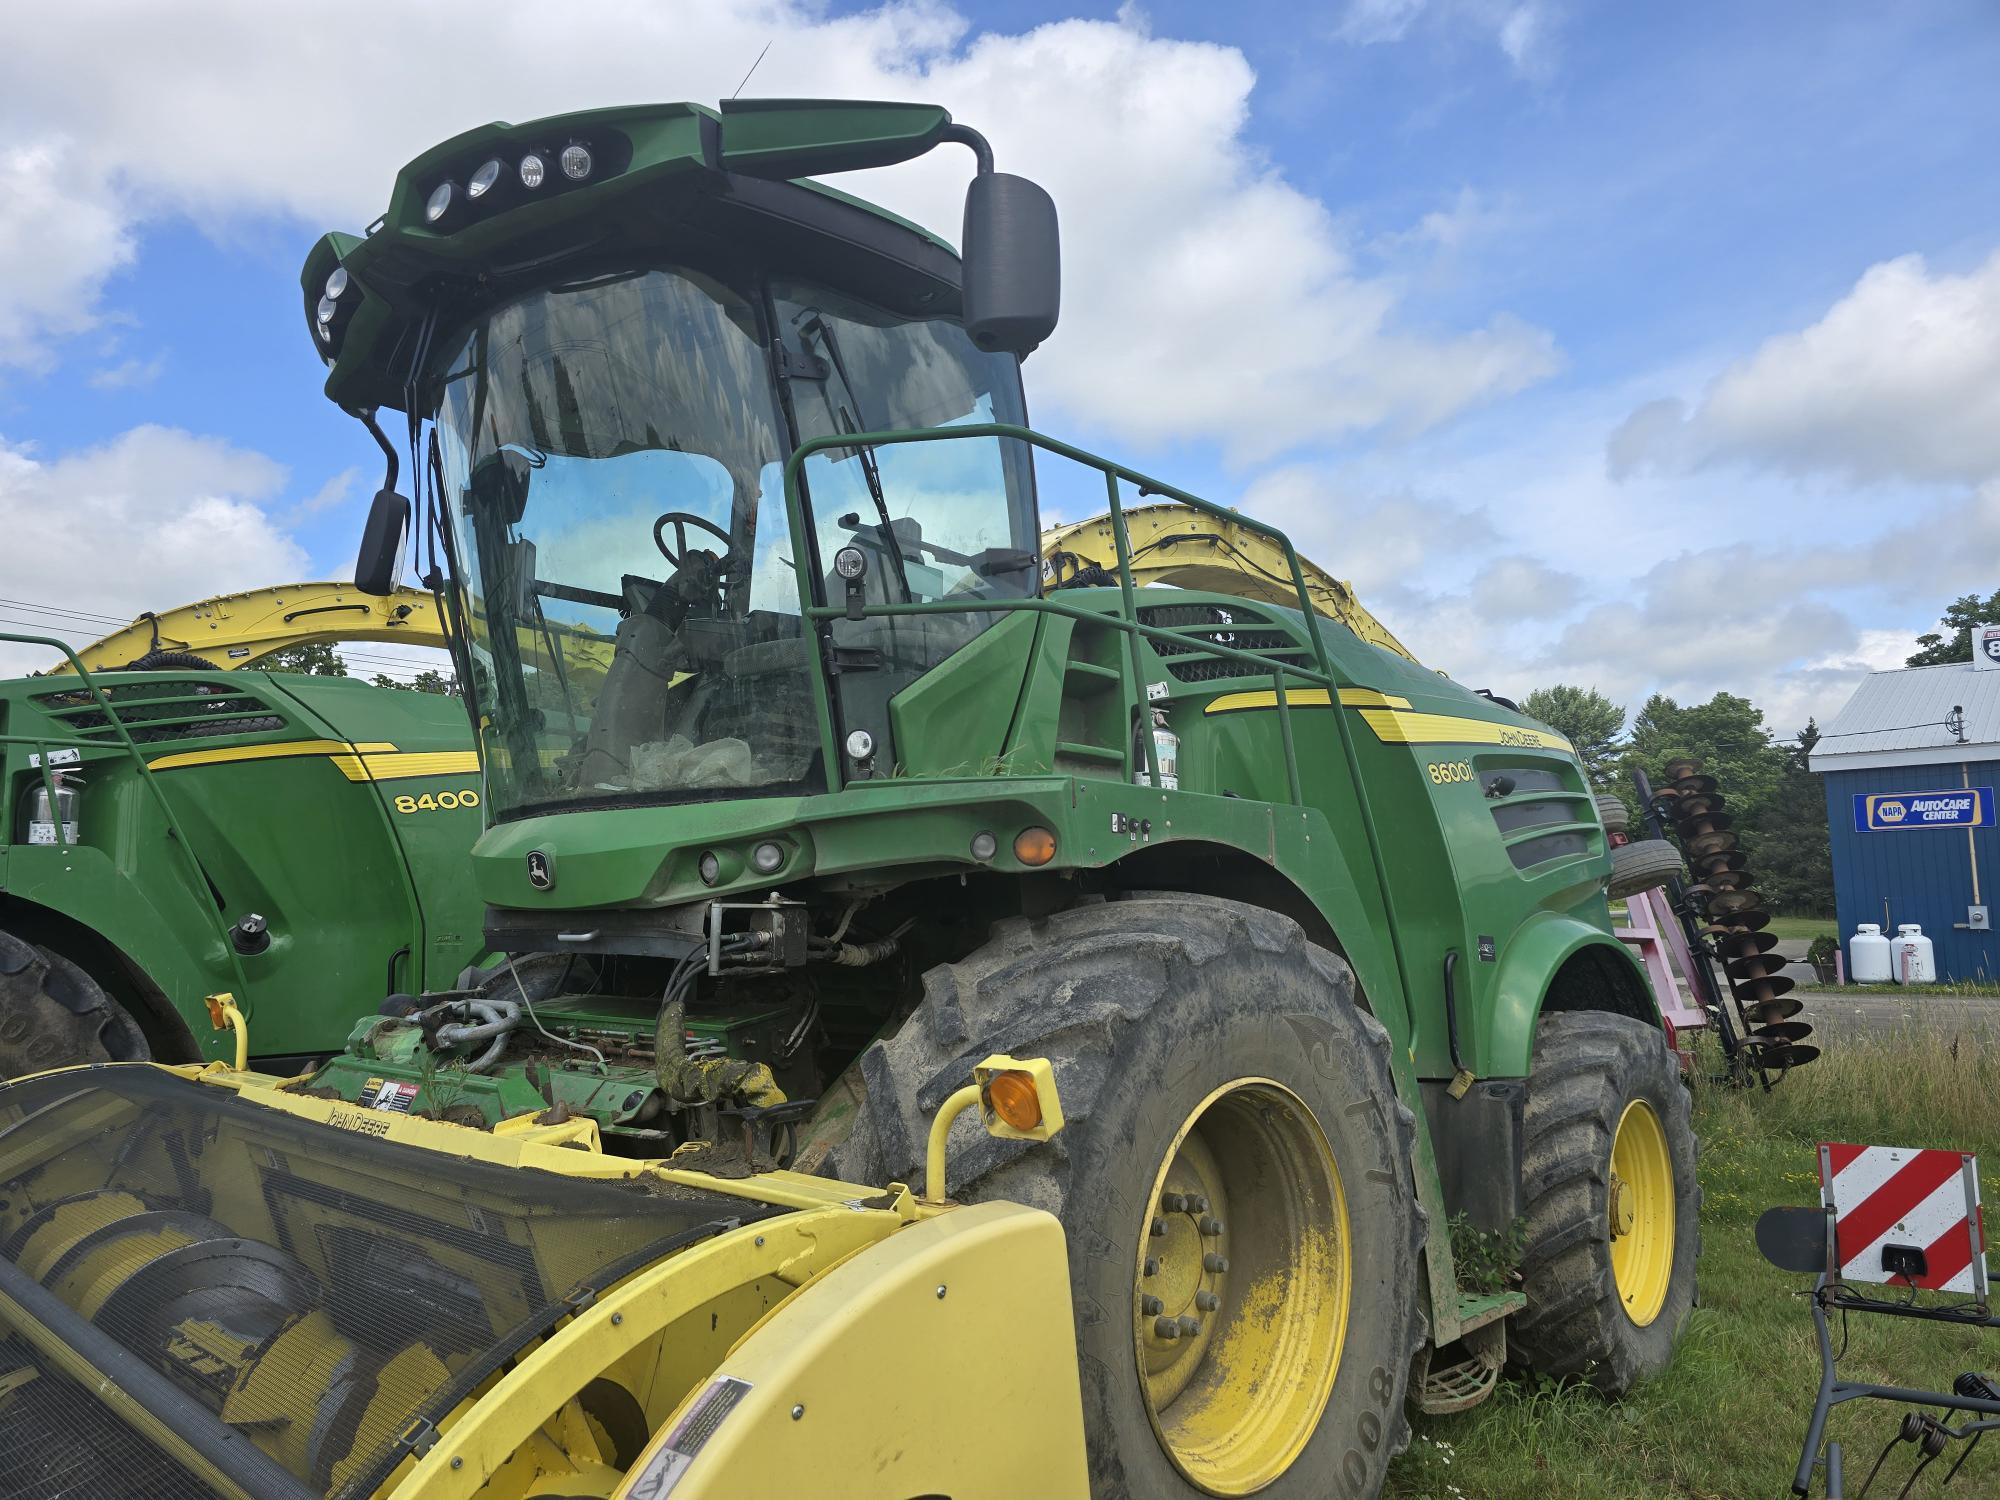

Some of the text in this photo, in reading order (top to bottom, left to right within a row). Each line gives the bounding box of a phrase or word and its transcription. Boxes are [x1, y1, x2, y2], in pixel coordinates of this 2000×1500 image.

[1427, 758, 1474, 785] 8600i
[394, 789, 480, 814] 8400
[1882, 806, 1903, 817] NAPA
[1922, 810, 1959, 820] CENTER
[324, 1106, 390, 1138] JOHN DEERE
